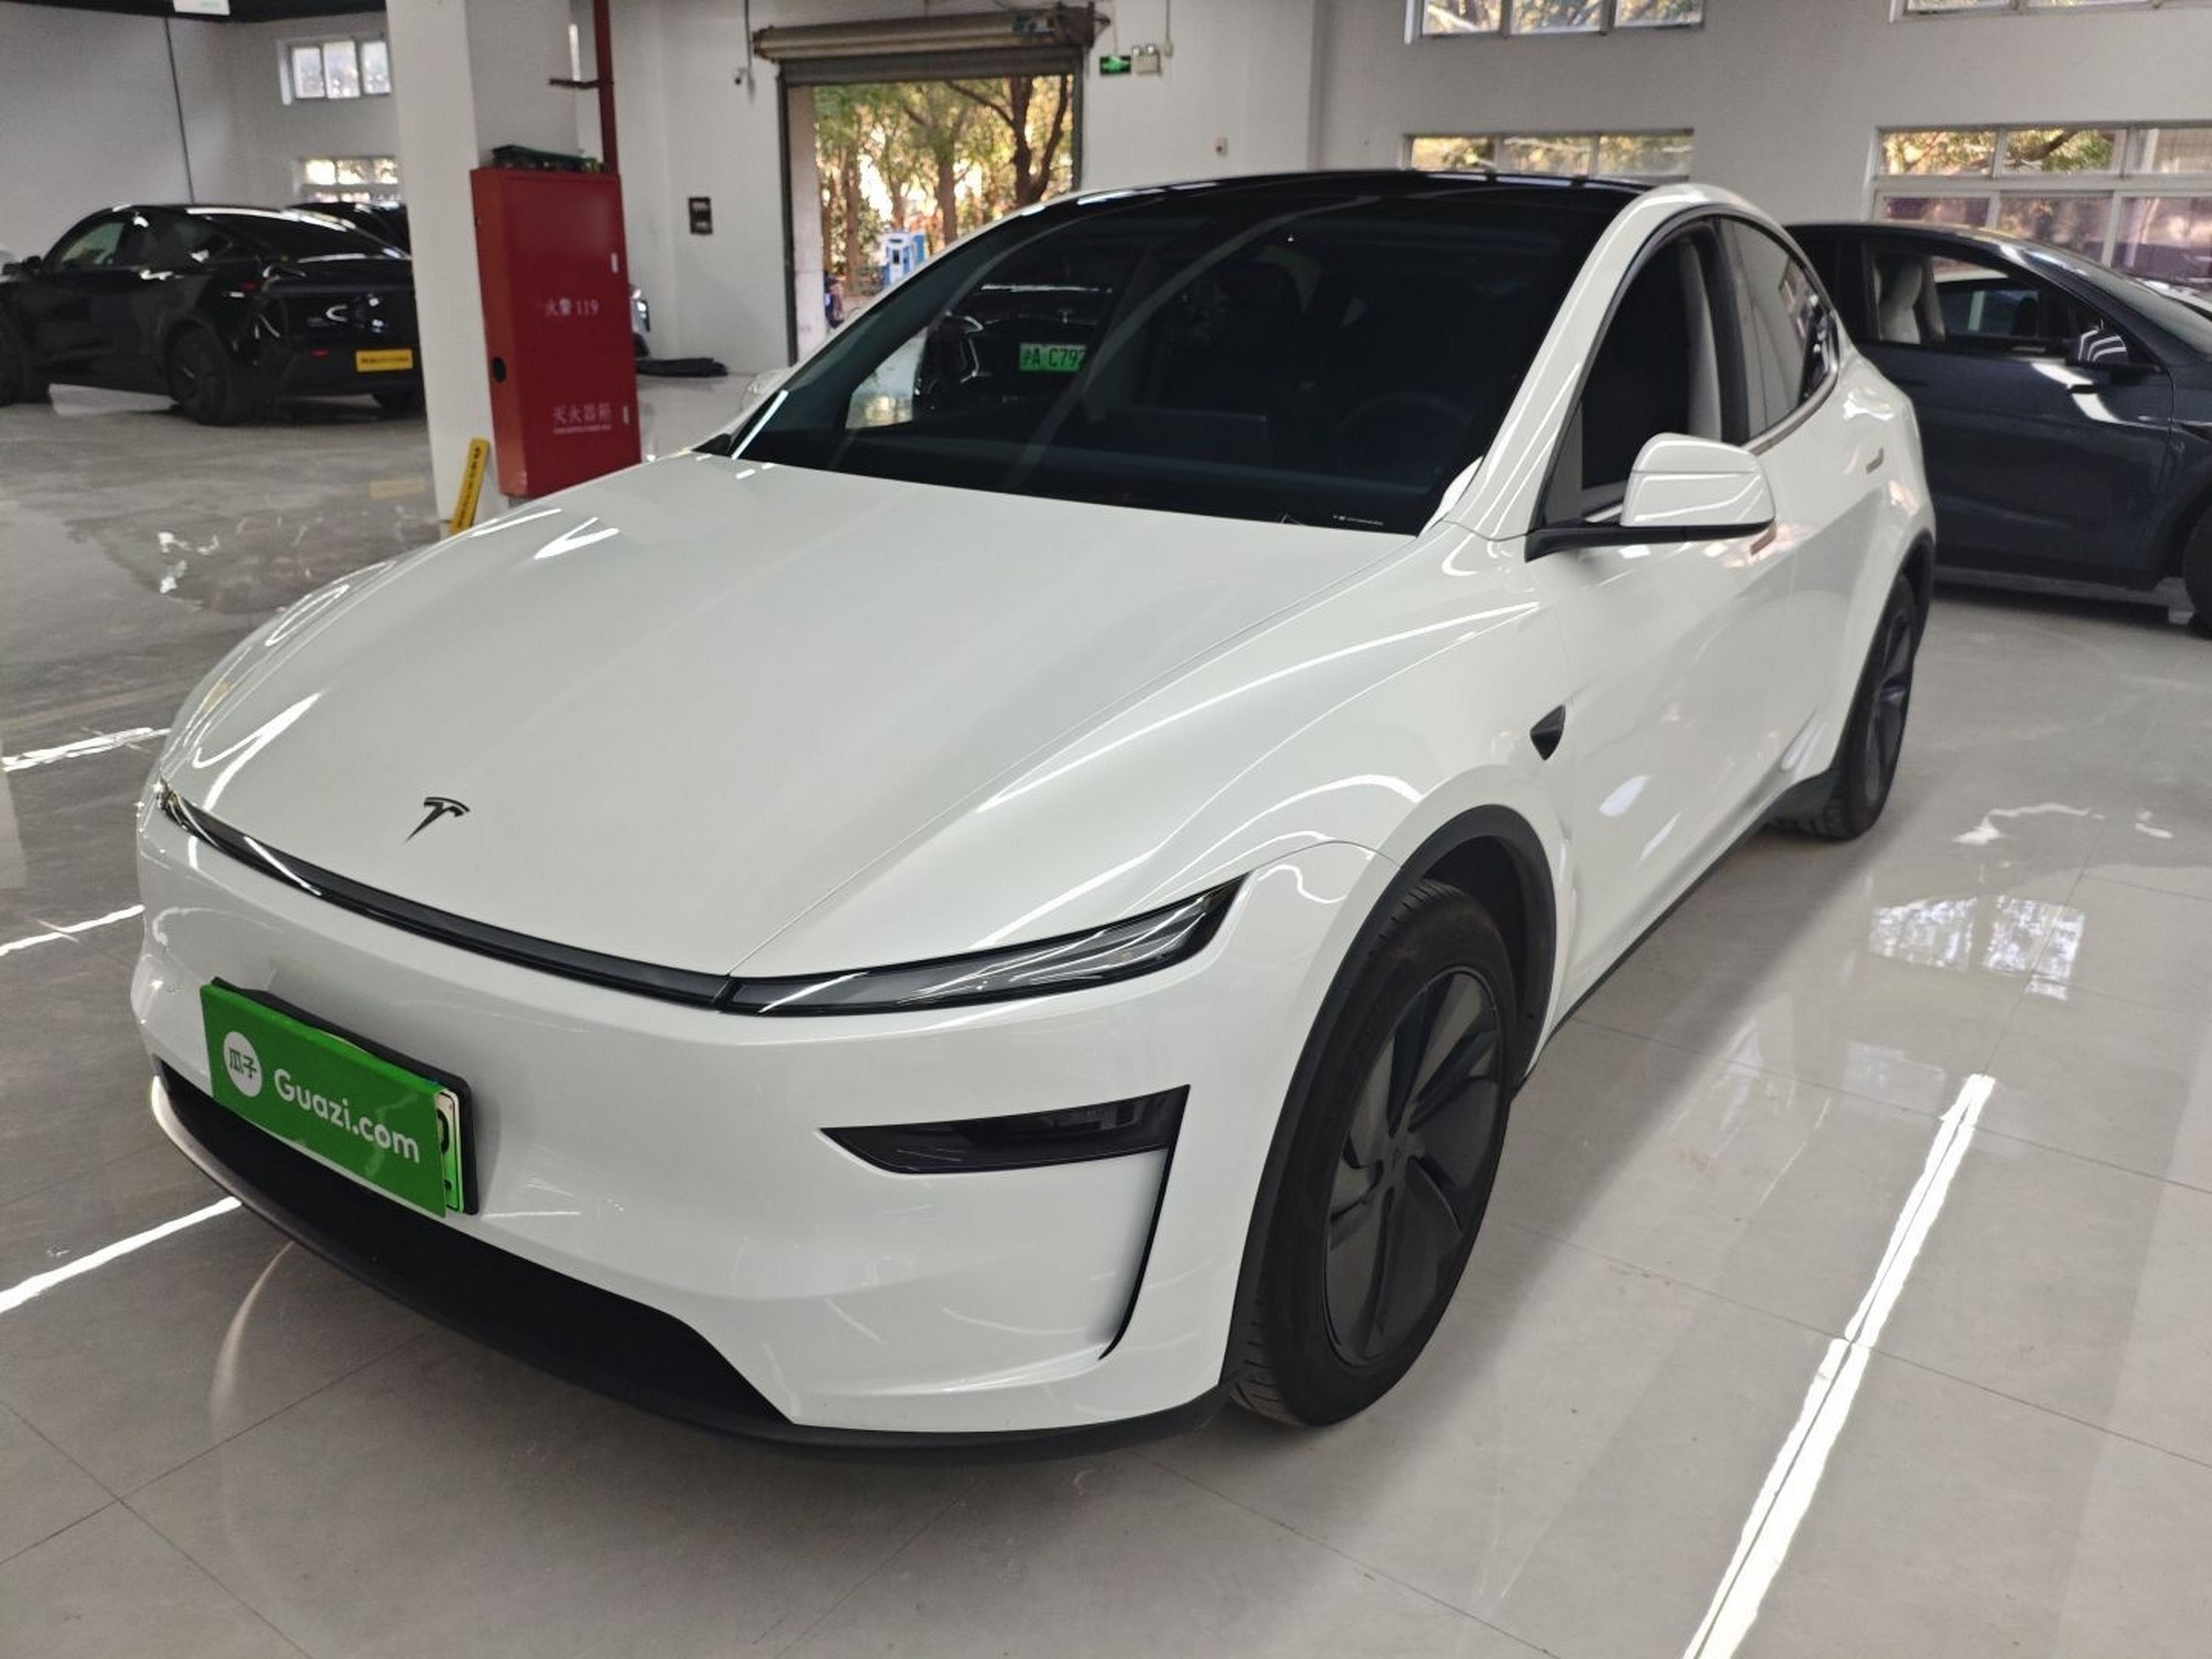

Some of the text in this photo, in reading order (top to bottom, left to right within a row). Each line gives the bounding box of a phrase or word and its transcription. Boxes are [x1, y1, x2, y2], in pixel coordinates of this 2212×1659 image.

[577, 299, 600, 316] 119
[229, 1047, 257, 1079] 瓜子
[274, 1069, 420, 1164] Guazi.com
